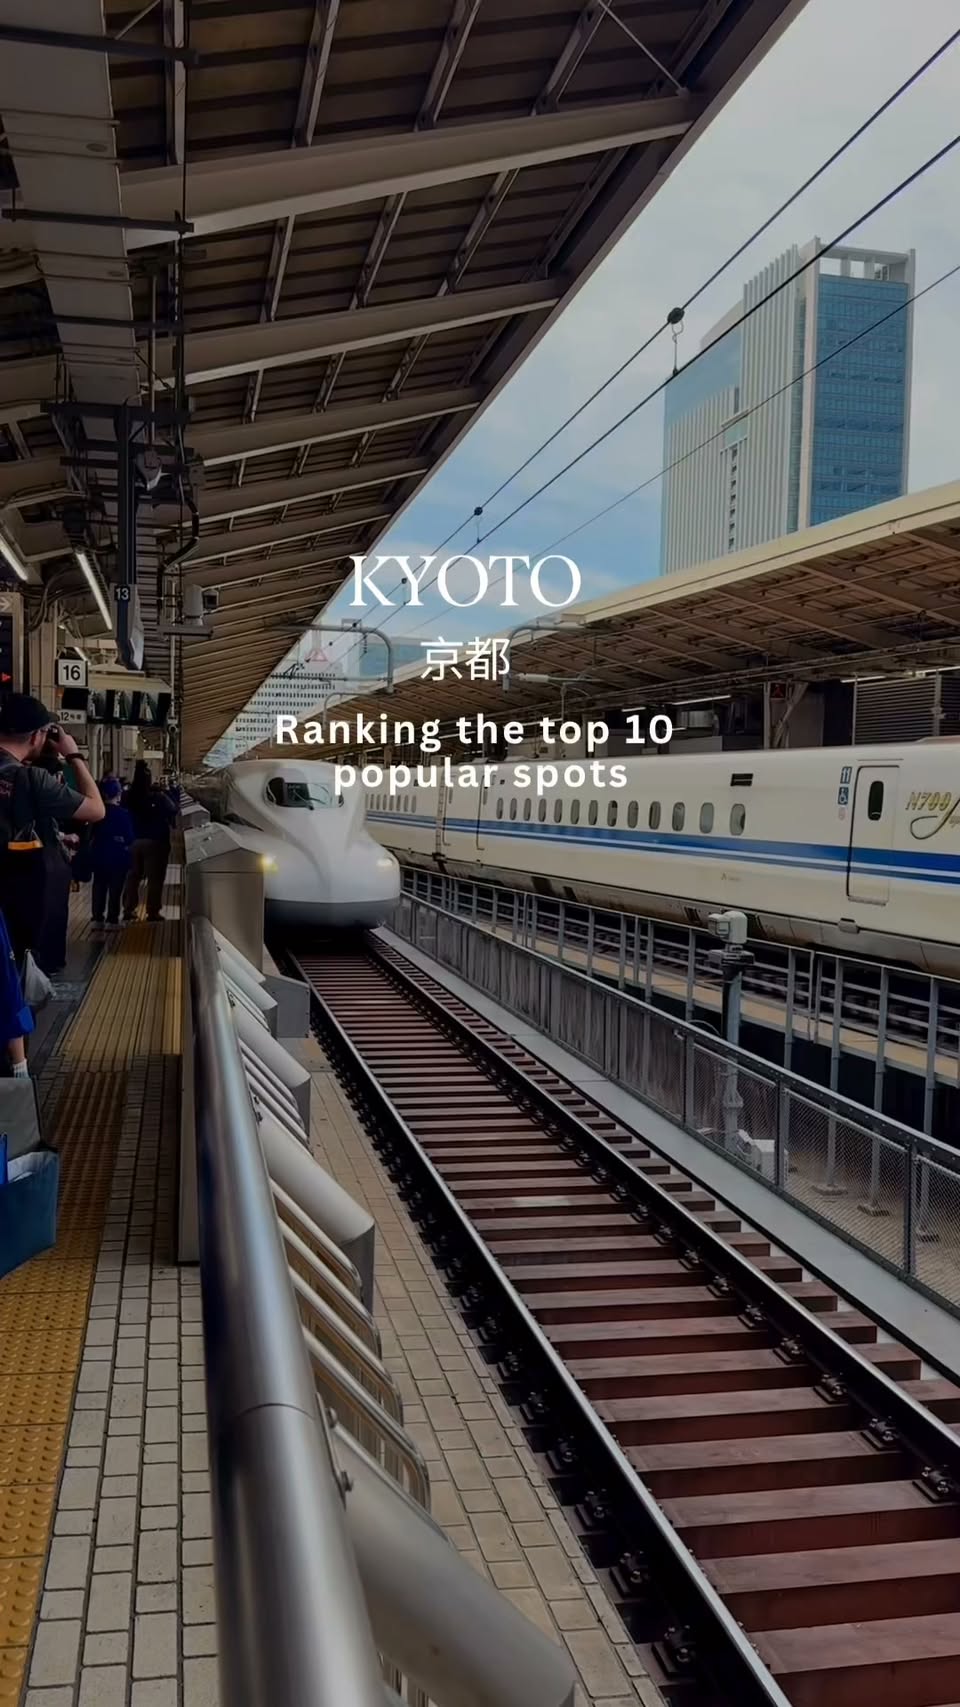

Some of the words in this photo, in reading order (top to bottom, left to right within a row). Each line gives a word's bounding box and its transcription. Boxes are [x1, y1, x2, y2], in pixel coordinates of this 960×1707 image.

[116, 587, 129, 600] 13
[63, 665, 81, 681] 16
[905, 791, 952, 811] N700
